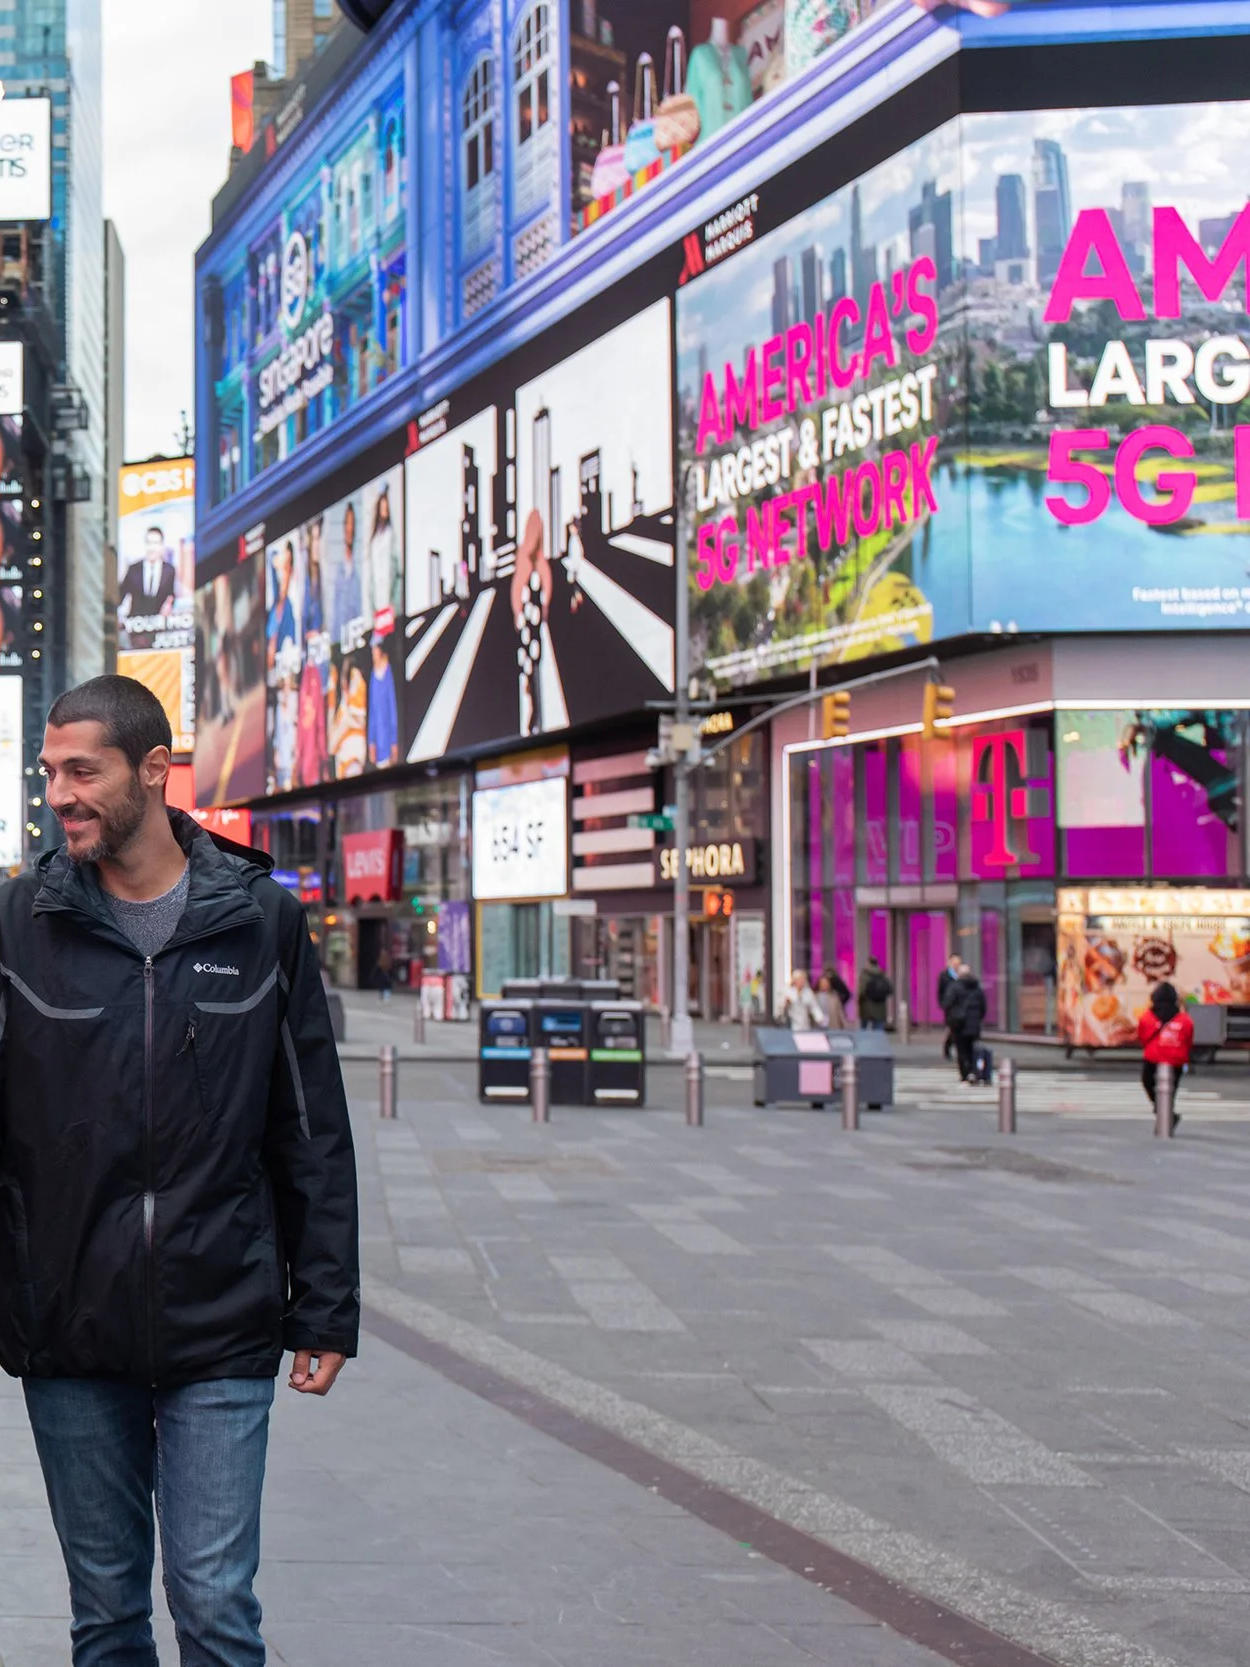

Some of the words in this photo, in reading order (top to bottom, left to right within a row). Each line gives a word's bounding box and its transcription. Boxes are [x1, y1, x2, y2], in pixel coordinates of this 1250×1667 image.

[704, 193, 759, 243] MARRIOTT
[705, 219, 753, 263] MARQUIS
[696, 255, 940, 456] AMERICA'S
[1048, 337, 1250, 409] LARG
[696, 433, 794, 513] LARGEST
[797, 416, 821, 471] &
[821, 364, 938, 464] FASTEST
[1045, 424, 1198, 527] 5G
[695, 518, 739, 592] 5G
[746, 436, 940, 575] NETWORK
[202, 963, 239, 976] Columbia
